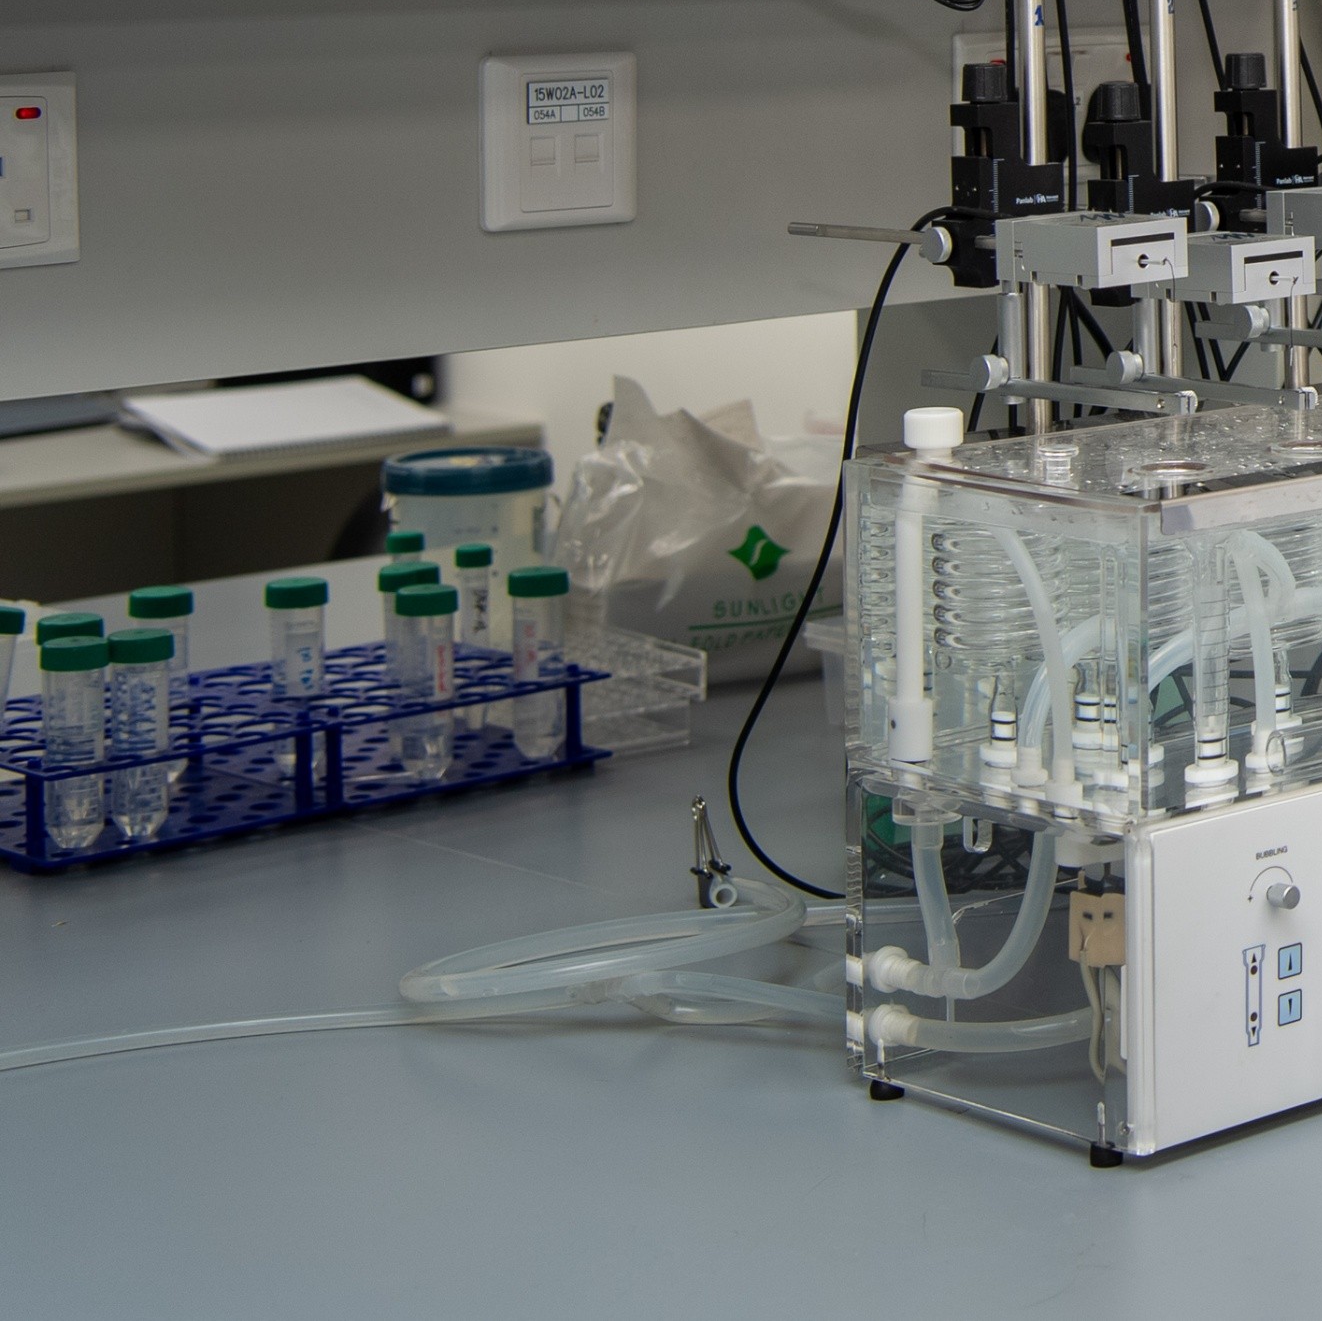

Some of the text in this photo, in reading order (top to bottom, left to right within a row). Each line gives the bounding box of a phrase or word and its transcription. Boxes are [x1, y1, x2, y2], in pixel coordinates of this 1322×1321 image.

[1034, 5, 1044, 27] 1
[534, 84, 605, 102] 15W02A-L02
[534, 106, 606, 121] 054A 054B
[1276, 177, 1292, 185] Panlab
[1016, 196, 1034, 205] Panlab
[1256, 846, 1288, 860] BUBBLING
